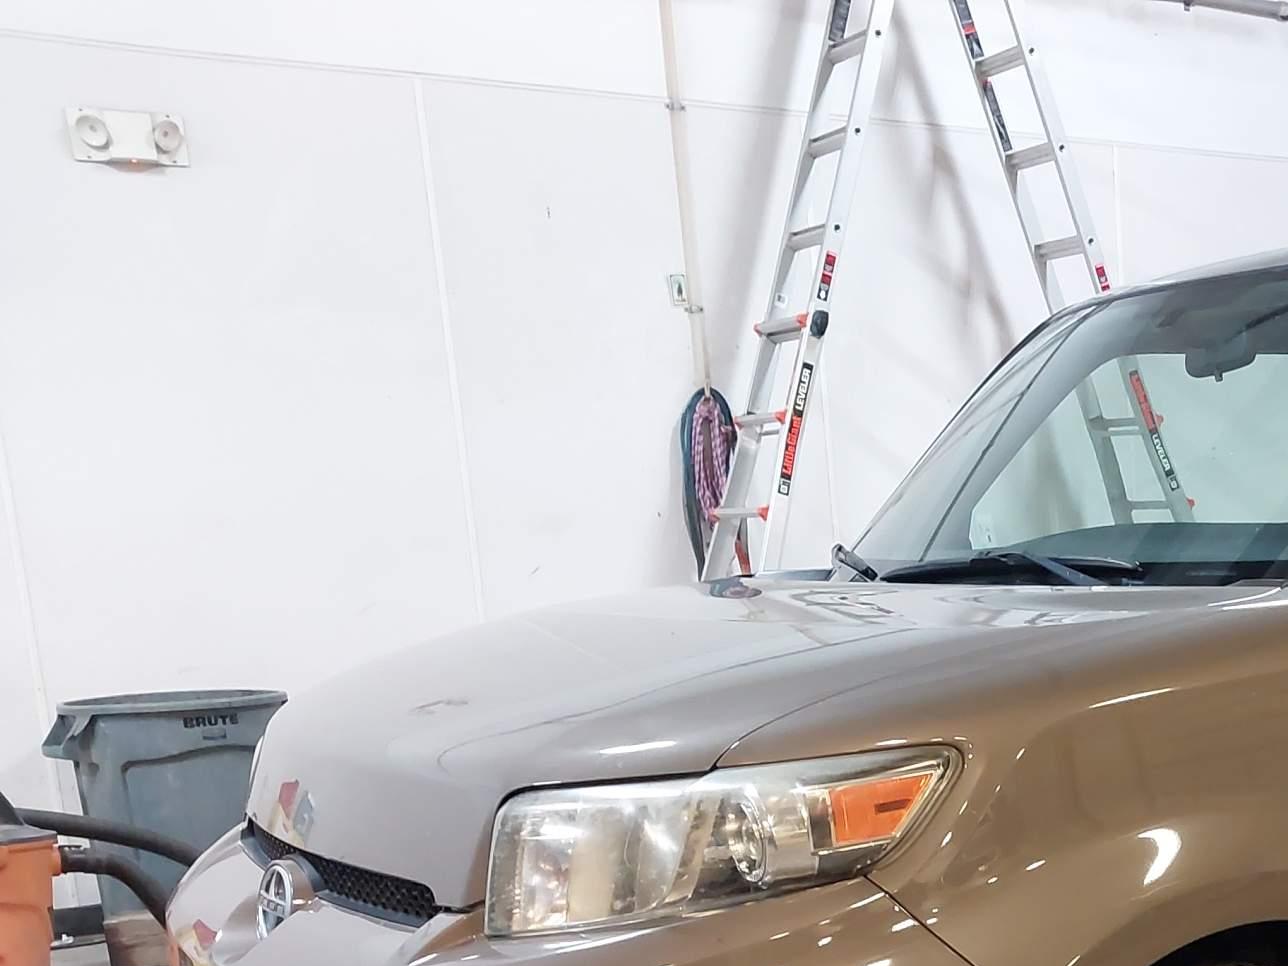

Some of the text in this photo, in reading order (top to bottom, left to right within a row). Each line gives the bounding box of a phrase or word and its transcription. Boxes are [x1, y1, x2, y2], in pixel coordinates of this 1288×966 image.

[794, 367, 812, 412] LEVELER
[1151, 433, 1171, 472] LEVELER
[183, 713, 239, 729] BRUTE
